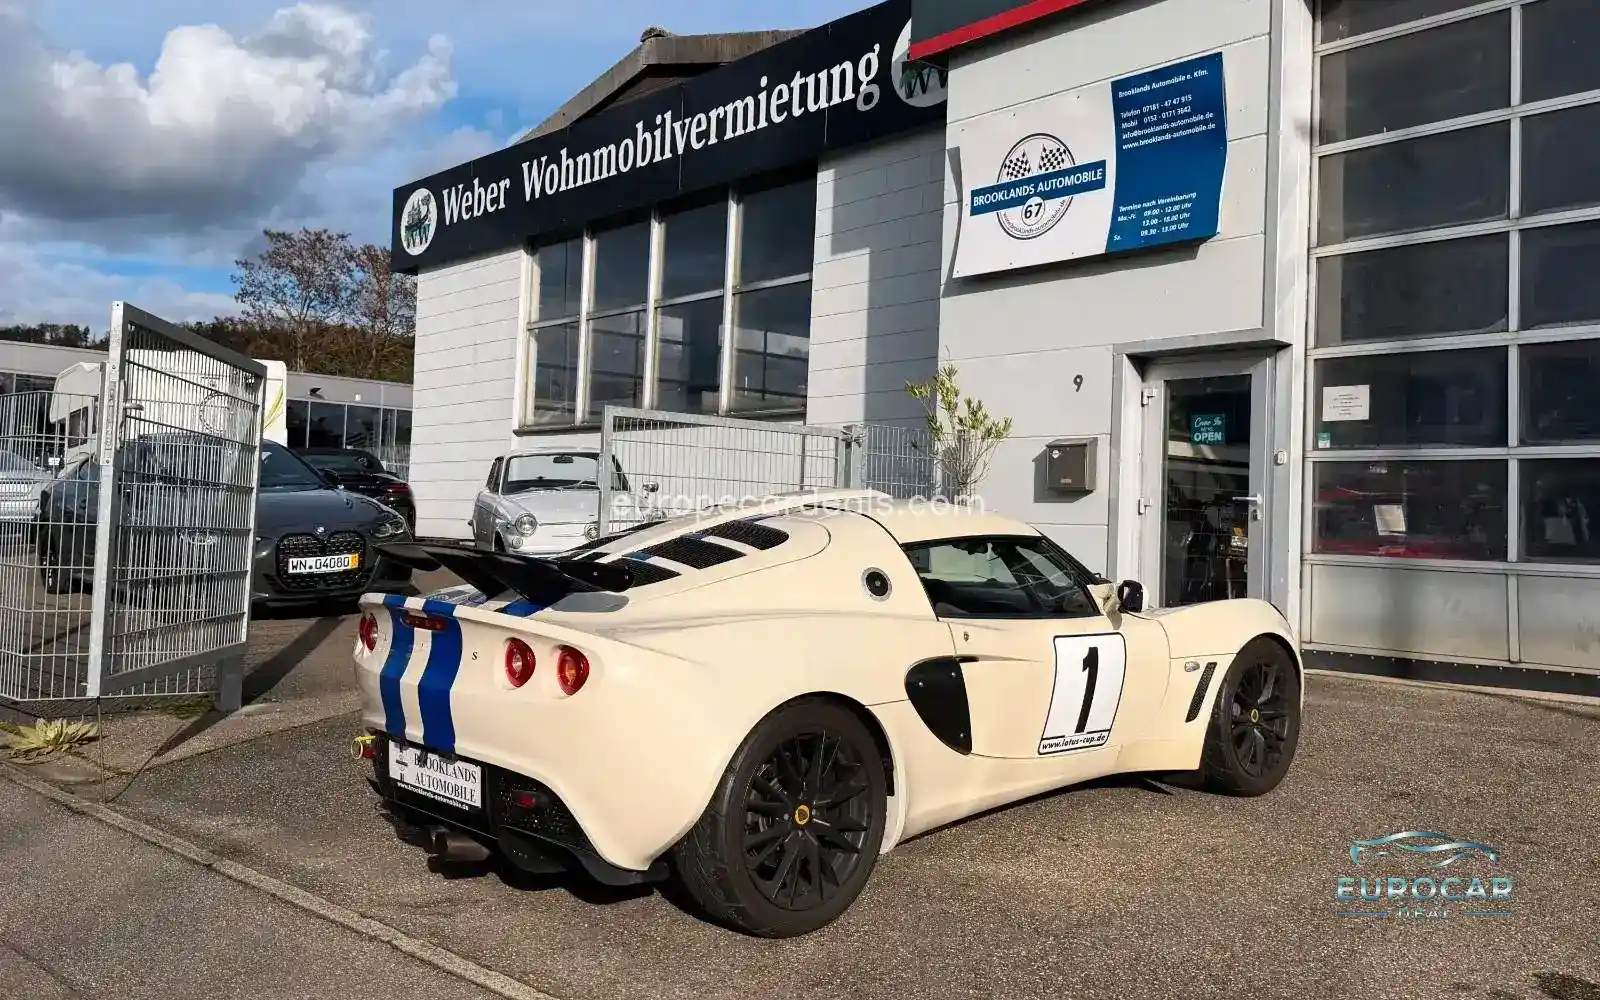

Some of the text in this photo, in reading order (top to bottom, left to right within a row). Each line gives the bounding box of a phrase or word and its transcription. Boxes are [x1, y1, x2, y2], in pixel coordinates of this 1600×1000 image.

[1118, 84, 1151, 98] Brooklands
[1151, 74, 1186, 89] Automobile
[1193, 68, 1209, 78] Kfm.
[1120, 108, 1141, 119] Telefon
[1142, 103, 1159, 113] 07181
[1164, 99, 1172, 107] 47
[1172, 97, 1180, 105] 47
[1180, 94, 1192, 103] 915
[1121, 119, 1138, 129] Mobil
[1143, 114, 1158, 124] 0152
[1161, 109, 1176, 119] 0171
[1122, 112, 1214, 140] info@brooklands-automobile.de
[442, 43, 882, 226] Weber Wohnmobilvermietung
[1122, 122, 1216, 150] www.brooklands-automobile.de
[973, 168, 1103, 207] BROOKLANDS AUTOMOBILE
[1024, 202, 1043, 220] 67
[1118, 191, 1197, 213] Termine nach Vereinbarung
[1164, 204, 1180, 213] 12.00
[1181, 202, 1193, 210] Uhr
[1142, 218, 1158, 227] 13.00
[1179, 212, 1191, 220] Uhr
[1177, 222, 1190, 230] Uhr
[1073, 374, 1083, 393] 9
[1194, 417, 1212, 428] Come
[1193, 431, 1222, 442] OPEN
[471, 650, 478, 661] S
[1074, 646, 1099, 734] 1
[1042, 733, 1106, 750] www.lotus-cup.de
[414, 752, 477, 784] BOOKLANDS
[397, 782, 469, 811] www.brooklands-automobile.de
[415, 771, 477, 804] AUTOMOBILE
